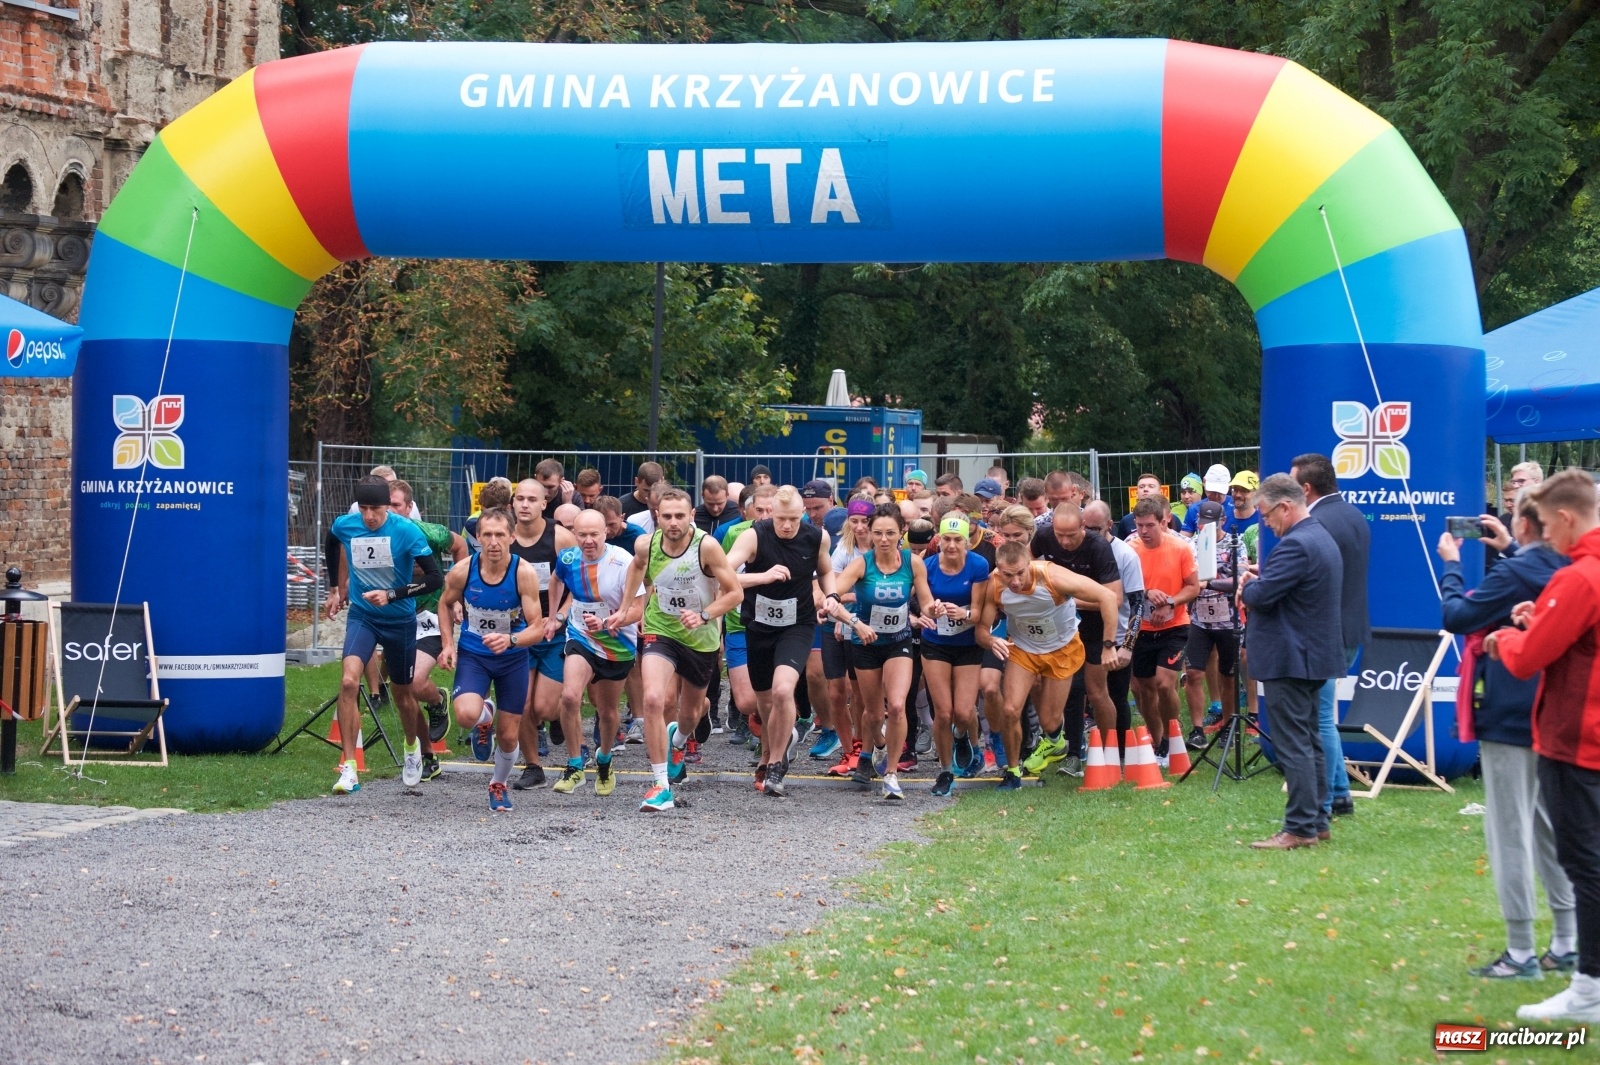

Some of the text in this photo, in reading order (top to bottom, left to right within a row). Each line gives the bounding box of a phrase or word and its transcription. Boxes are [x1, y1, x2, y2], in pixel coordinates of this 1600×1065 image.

[459, 66, 1056, 109] GMINA KRZYŻANOWICE
[647, 147, 861, 225] META
[26, 336, 63, 364] pepsi
[80, 477, 234, 495] GMINA KRZYŻANOWICE
[100, 501, 121, 510] odkryj
[156, 501, 201, 511] zapamiętaj
[366, 546, 376, 559] 2
[669, 597, 686, 608] 48
[767, 606, 783, 619] 33
[1208, 605, 1215, 616] 5
[421, 618, 436, 631] 94
[480, 618, 496, 630] 26
[883, 614, 900, 626] 60
[1027, 625, 1044, 635] 35
[65, 633, 142, 661] safer
[1359, 661, 1430, 691] safe
